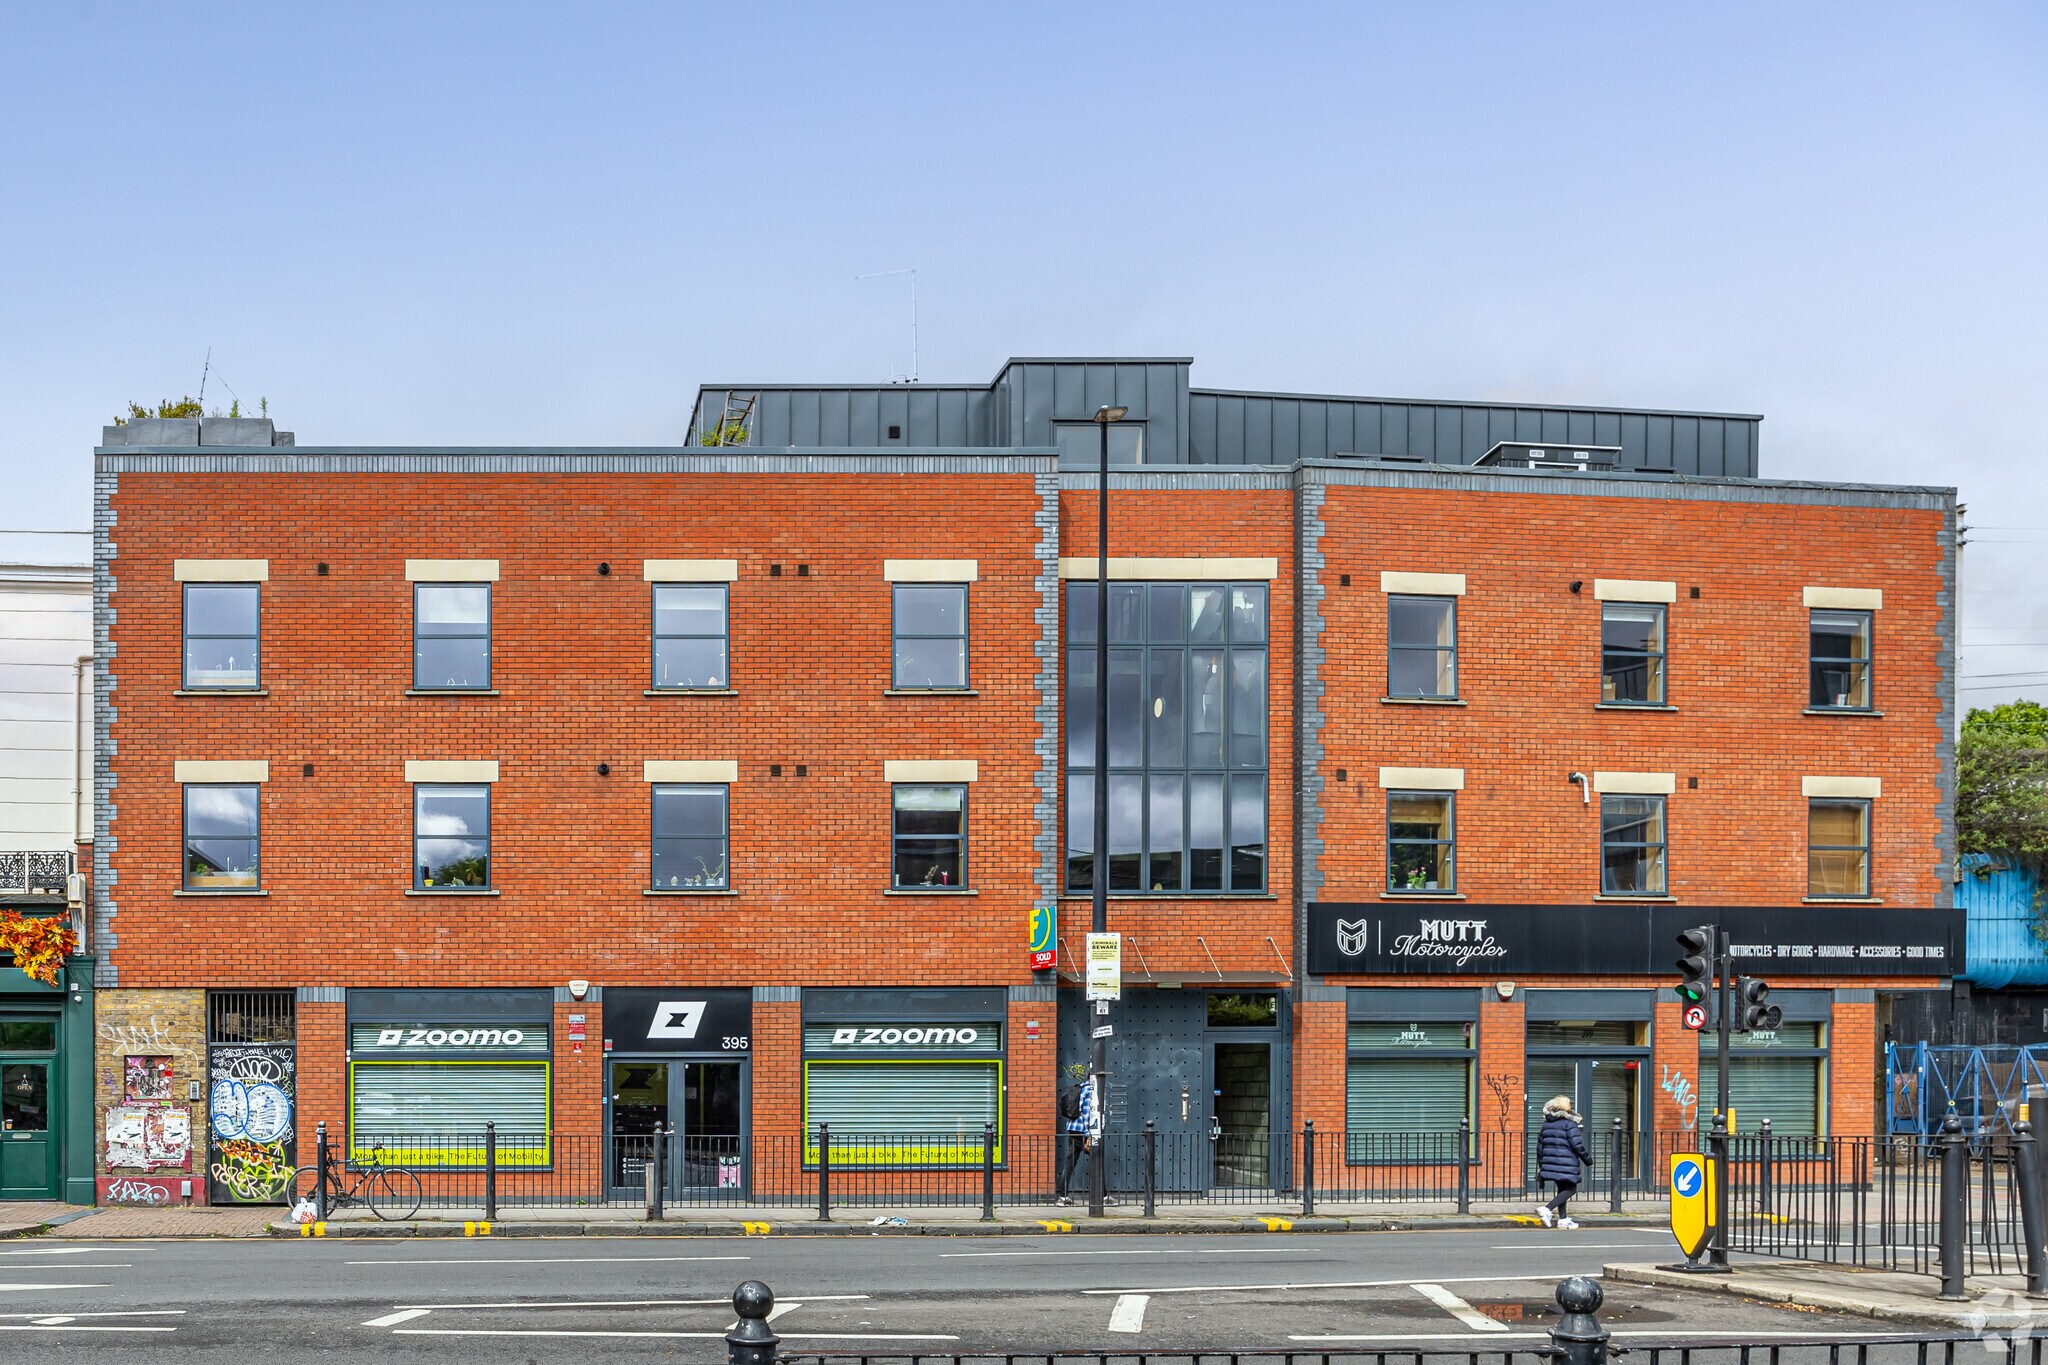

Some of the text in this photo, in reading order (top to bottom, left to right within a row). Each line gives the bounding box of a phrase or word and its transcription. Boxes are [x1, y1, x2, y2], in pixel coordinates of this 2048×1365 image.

[1419, 918, 1487, 942] MUTT
[1036, 952, 1051, 962] SOLD
[1390, 935, 1508, 967] Motorcycles
[1777, 945, 1791, 957] DRY
[1792, 945, 1813, 957] GOODS
[1818, 945, 1855, 958] HARDWARE
[1859, 945, 1901, 958] ACCESSORIES
[1906, 946, 1923, 958] GOOD
[1925, 946, 1944, 958] TIMES
[405, 1029, 524, 1046] zoomo
[861, 1028, 978, 1044] zoomo
[1401, 1031, 1425, 1040] MUTT
[1752, 1031, 1776, 1039] MUTT
[722, 1036, 748, 1050] 395
[448, 1152, 466, 1160] The
